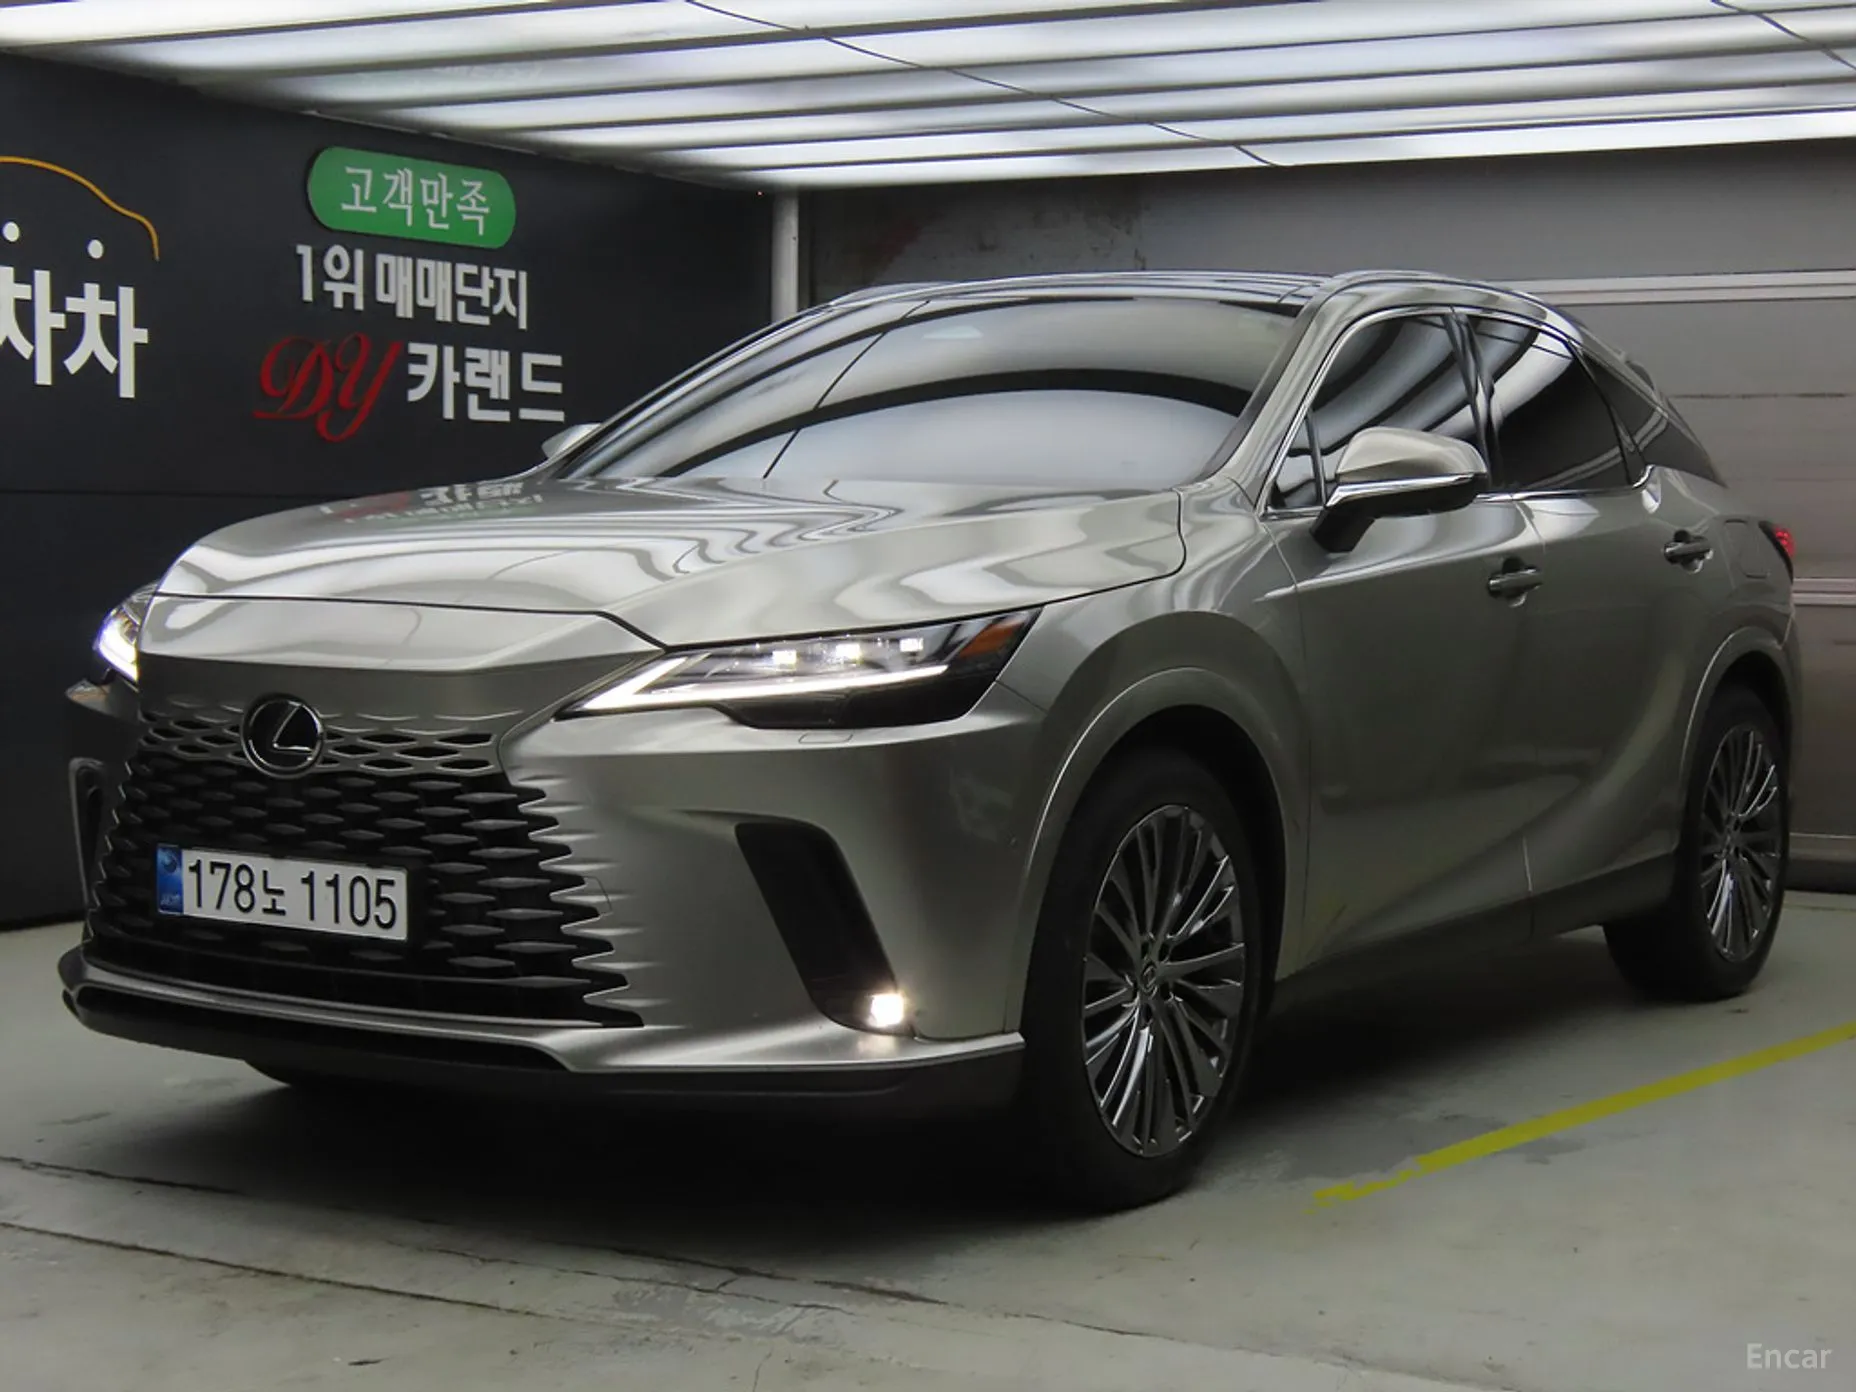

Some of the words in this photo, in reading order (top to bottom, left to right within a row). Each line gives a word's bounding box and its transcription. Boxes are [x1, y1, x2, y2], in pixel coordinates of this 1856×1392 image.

[341, 166, 490, 236] 고객만족
[296, 244, 365, 311] 1위
[376, 253, 528, 330] 매매단지
[253, 332, 404, 443] DY
[407, 342, 565, 422] 카랜드
[188, 858, 287, 917] 178노
[301, 870, 397, 930] 1105
